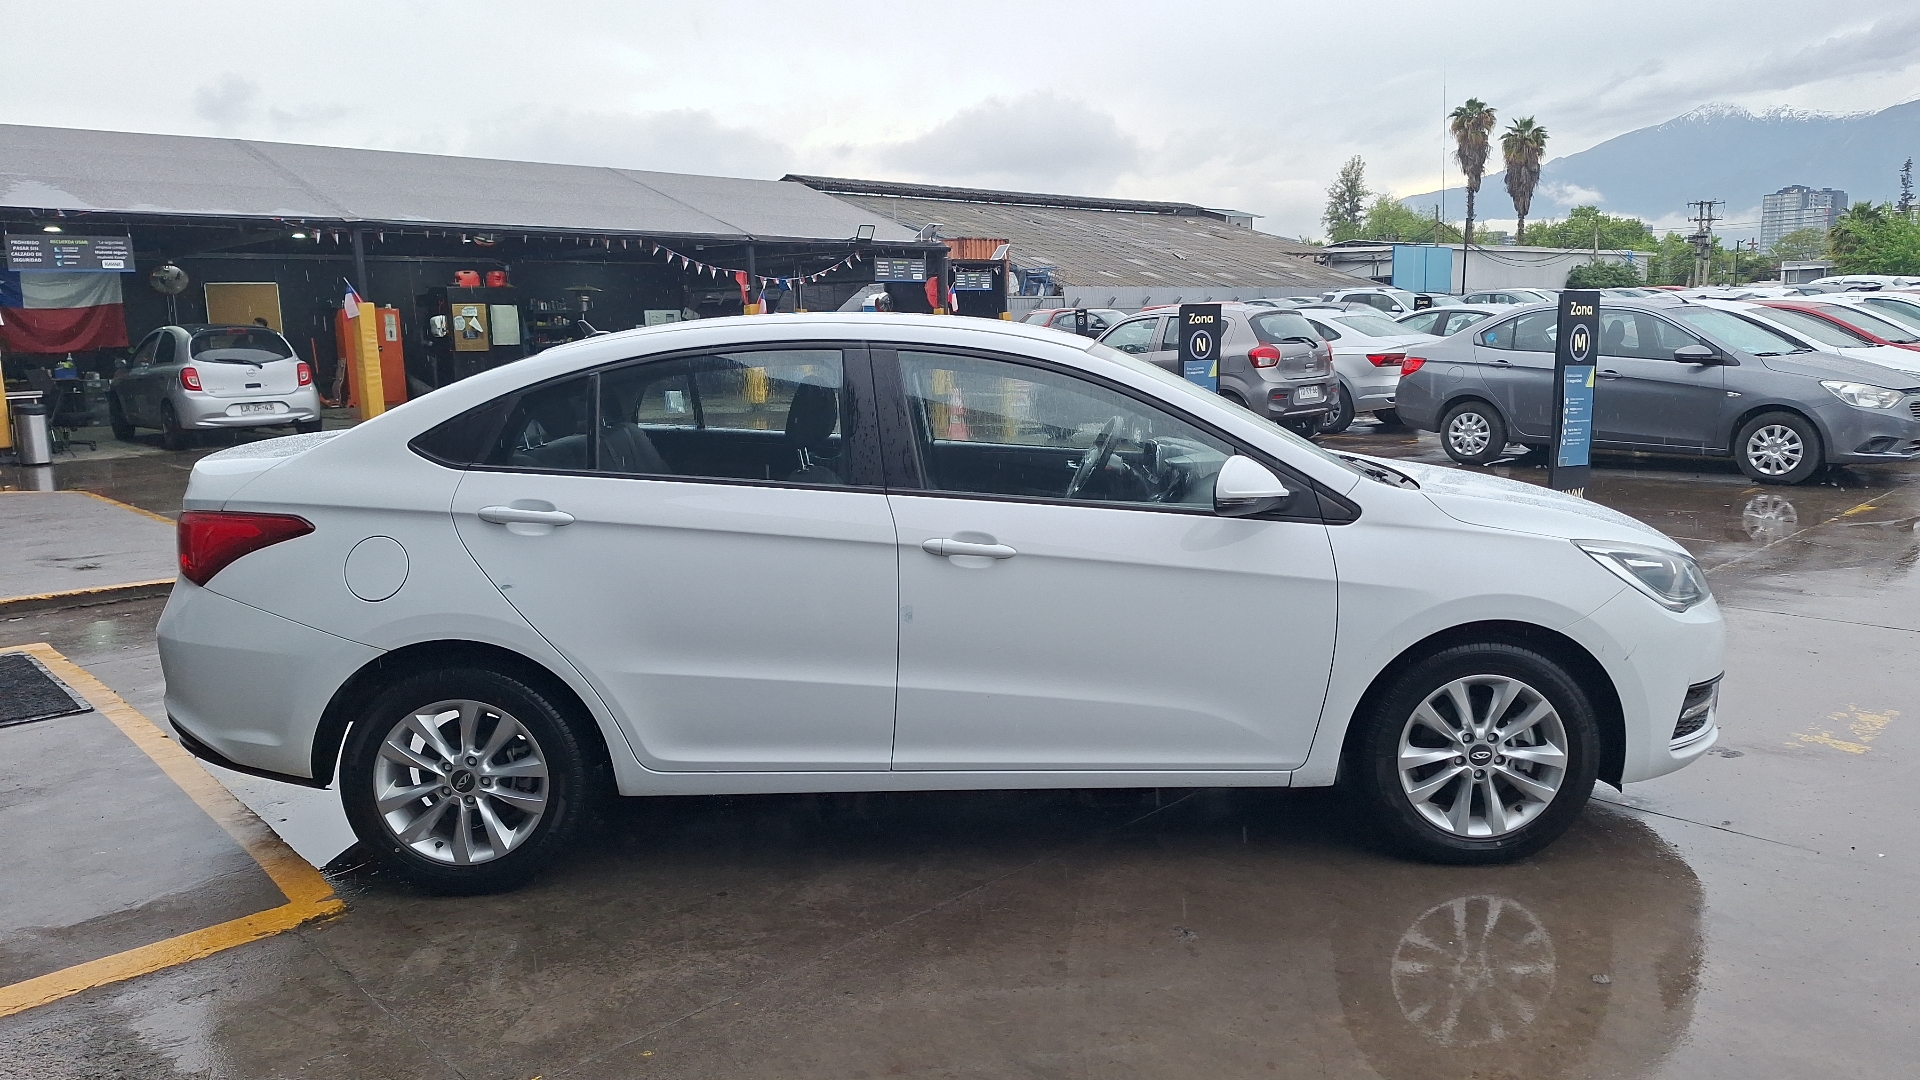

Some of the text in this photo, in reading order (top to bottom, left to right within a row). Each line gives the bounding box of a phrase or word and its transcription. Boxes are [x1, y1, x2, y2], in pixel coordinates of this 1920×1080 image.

[1570, 301, 1593, 316] Zona
[1188, 313, 1214, 324] Zona
[1196, 337, 1206, 352] N
[1574, 333, 1586, 352] M
